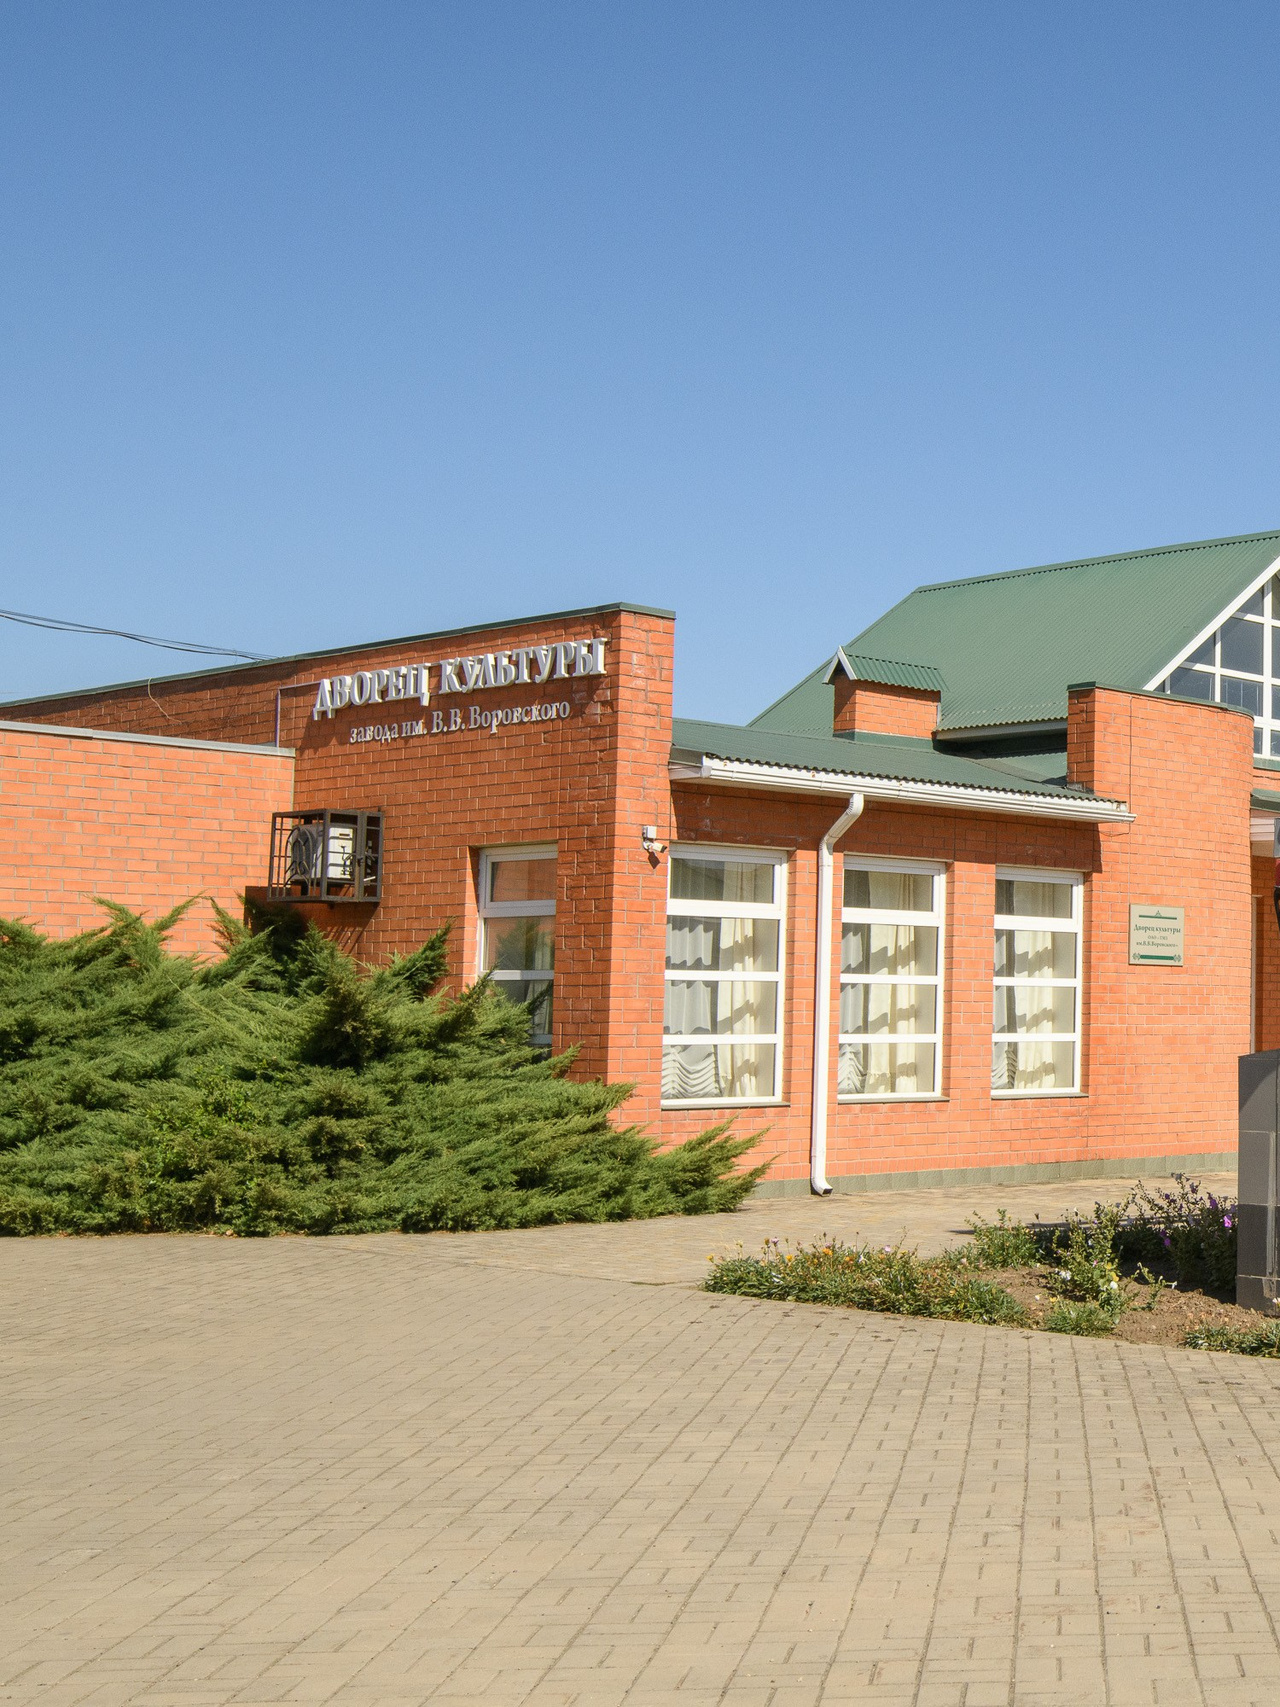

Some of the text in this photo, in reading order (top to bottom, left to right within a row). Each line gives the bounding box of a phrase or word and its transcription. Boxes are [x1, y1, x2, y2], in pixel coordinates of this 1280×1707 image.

[313, 638, 608, 721] ДВОРЕЦ КУЛЬТУРЫ
[350, 722, 399, 744] завода
[401, 719, 427, 738] им.
[469, 701, 571, 734] Воровского
[1134, 924, 1155, 933] Дворец
